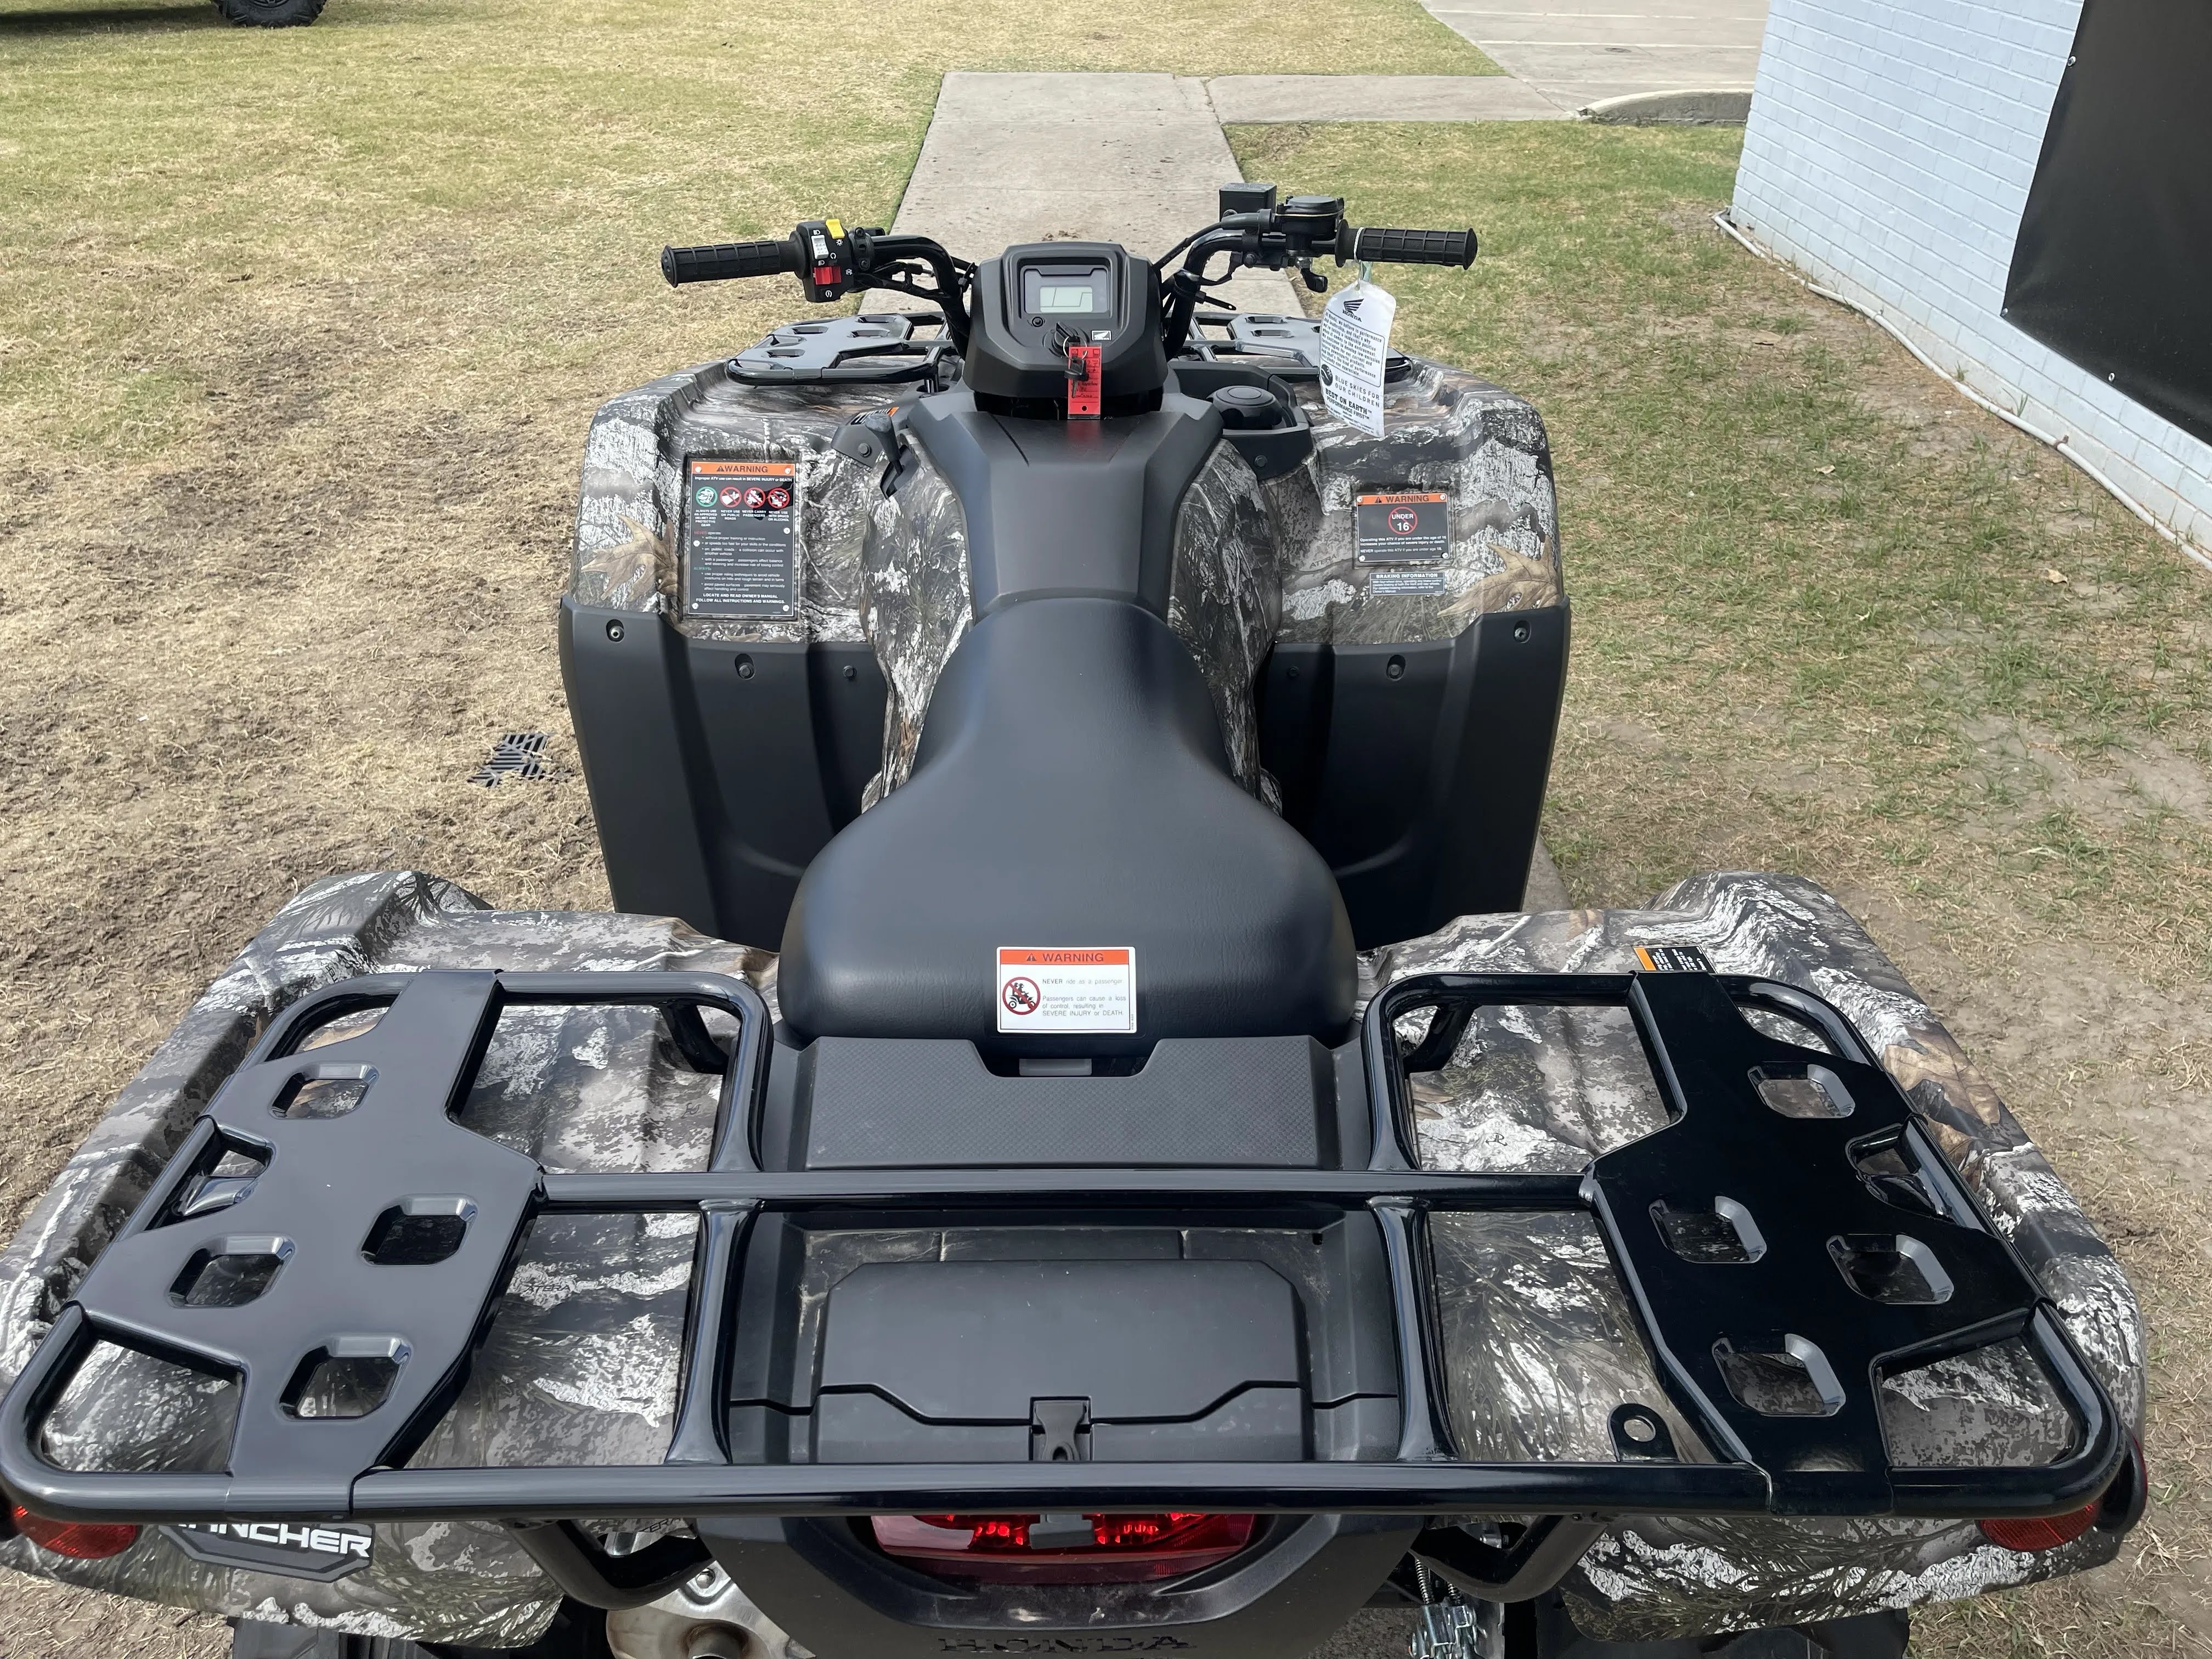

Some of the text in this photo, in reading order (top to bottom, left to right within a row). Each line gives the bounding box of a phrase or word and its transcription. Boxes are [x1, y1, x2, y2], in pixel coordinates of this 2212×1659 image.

[1342, 309, 1362, 322] HONDA
[1335, 375, 1379, 400] BLUE SKIES FOR
[1335, 383, 1379, 407] OUR CHILDREN
[1325, 388, 1338, 400] BEST
[1340, 397, 1346, 405] ON
[1327, 396, 1352, 414] PERFORMANCE
[1397, 522, 1409, 531] 16
[1309, 554, 1337, 569] ATERA
[1043, 953, 1104, 962] WARNING
[524, 1284, 570, 1293] ATERA
[178, 1523, 372, 1557] NCHER
[938, 1636, 1197, 1654] HONDA
